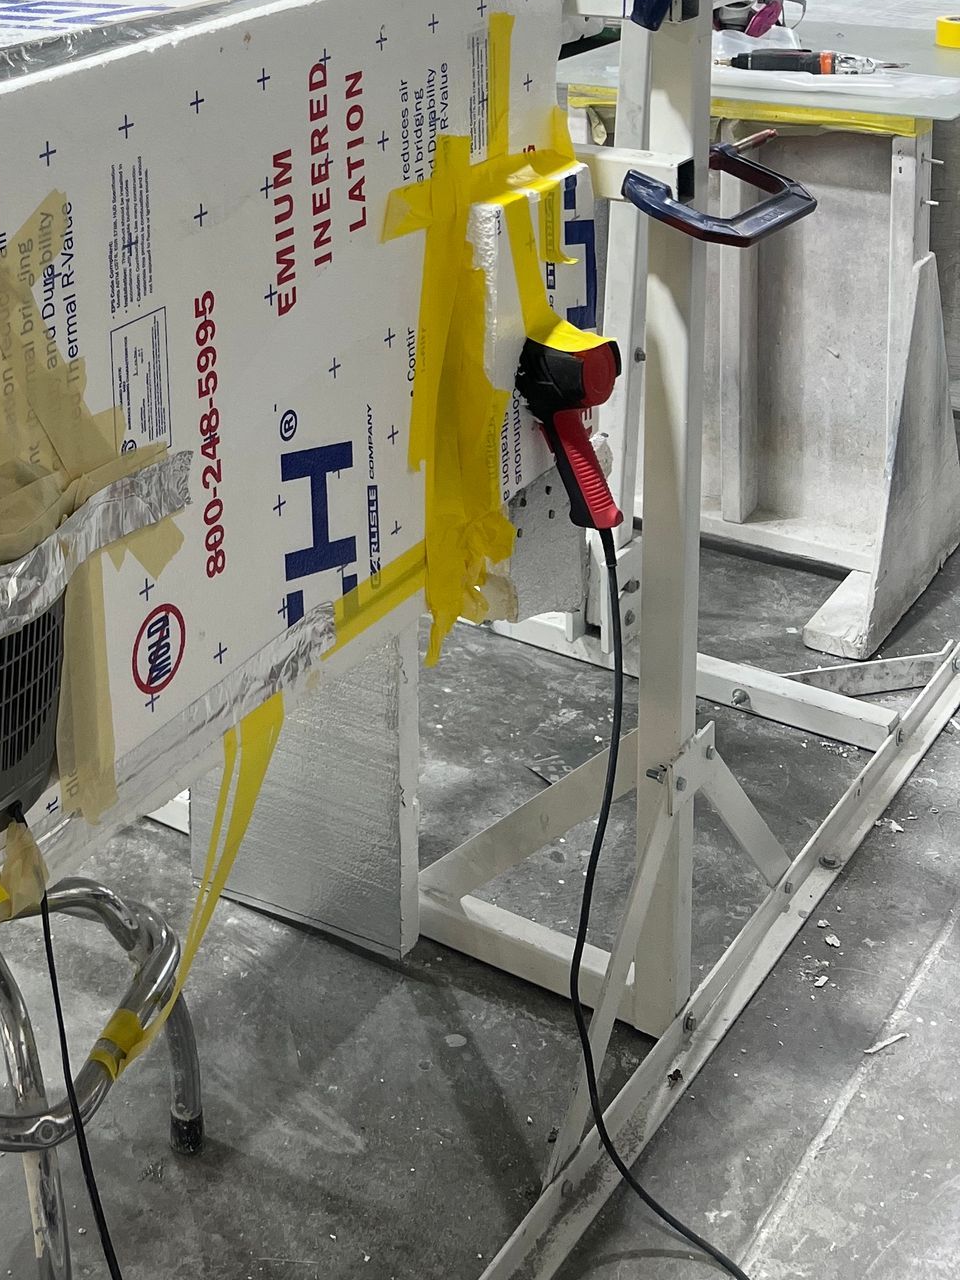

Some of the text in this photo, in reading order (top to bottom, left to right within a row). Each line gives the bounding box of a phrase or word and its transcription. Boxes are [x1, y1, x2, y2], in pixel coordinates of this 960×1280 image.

[399, 79, 411, 181] reduces air
[414, 87, 425, 164] bridging
[426, 68, 437, 154] Durability
[439, 62, 449, 131] R-Value
[345, 70, 367, 233] LATION
[59, 202, 75, 288] R-Value
[273, 148, 297, 317] EMIUM
[39, 211, 58, 371] and Durability
[194, 290, 227, 579] 800-248-5995
[366, 403, 375, 480] COMPANY
[147, 613, 172, 687] MOLD
